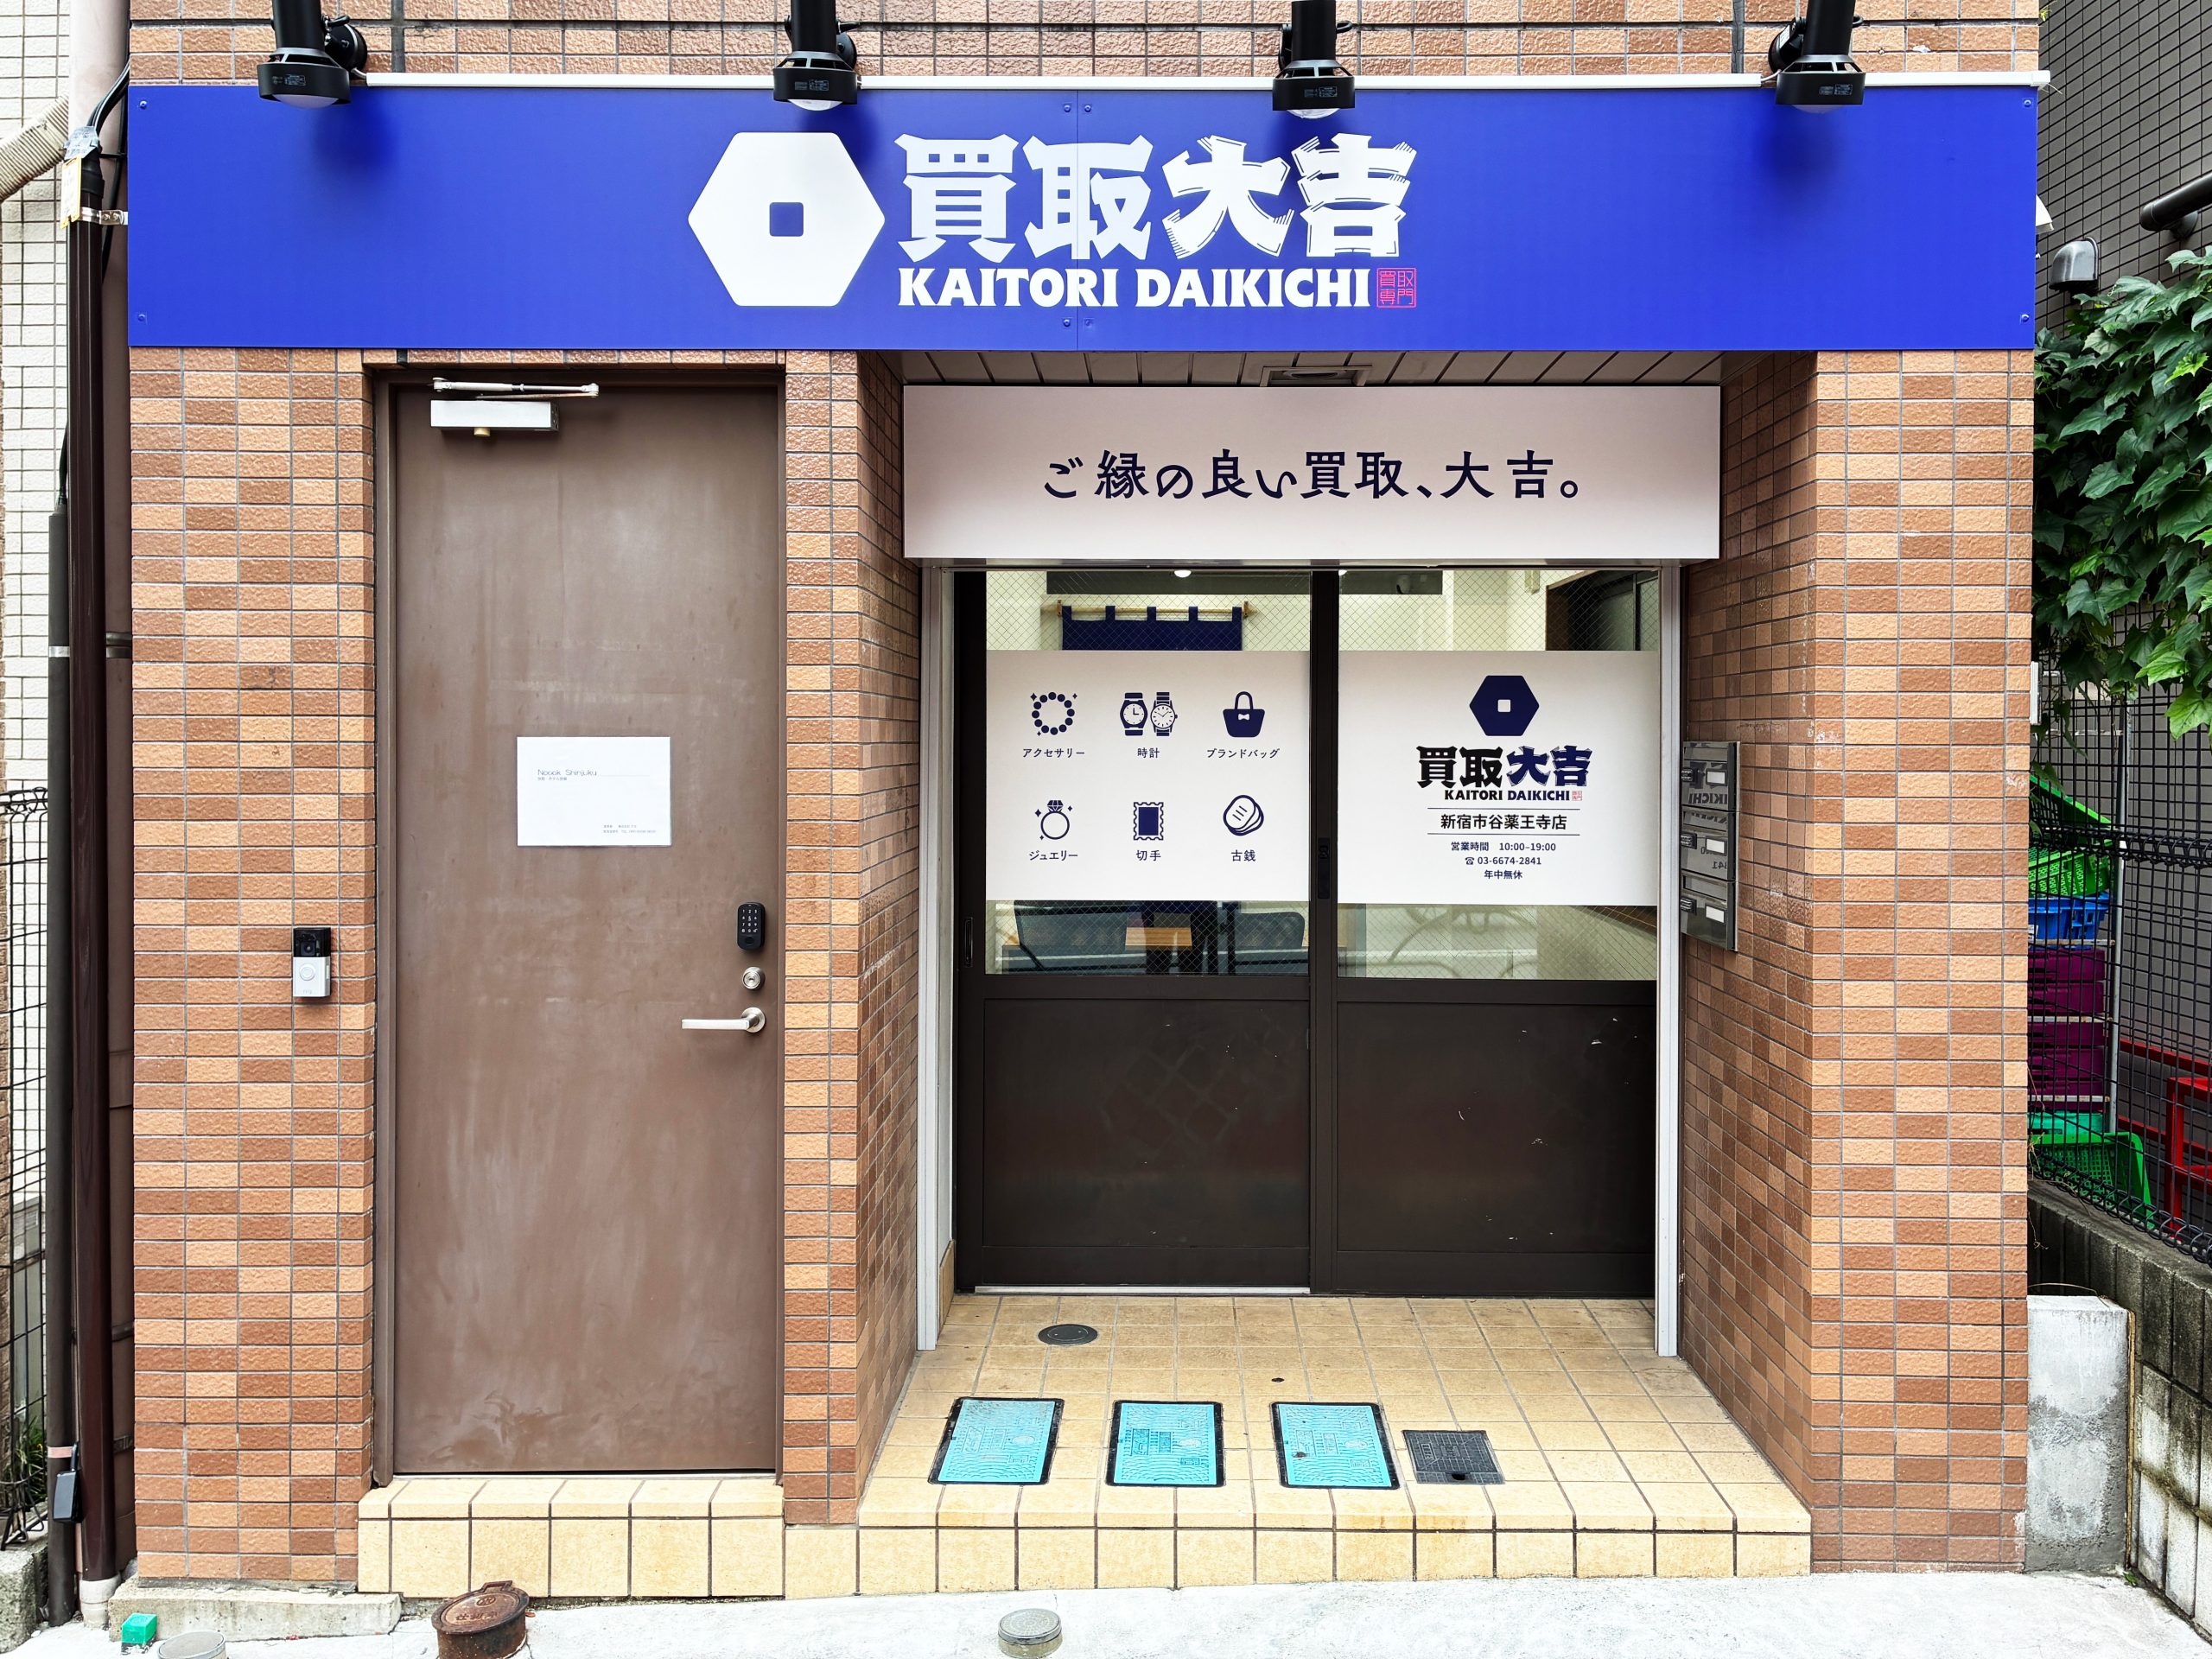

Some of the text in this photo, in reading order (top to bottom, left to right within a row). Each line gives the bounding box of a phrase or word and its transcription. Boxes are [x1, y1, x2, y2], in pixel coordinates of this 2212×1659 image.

[893, 132, 1417, 264] 買取大吉
[898, 268, 1371, 308] KAITORI DAIKICHI
[1044, 448, 1580, 499] ご縁の良い買取、大吉。
[1022, 747, 1085, 759] アクセサリー
[1137, 747, 1160, 759] 時計
[1206, 747, 1281, 760] ブランドバッグ
[1415, 745, 1592, 788] 買取大吉
[1444, 789, 1503, 801] KAITORI
[1507, 790, 1570, 801] DAIKICHI
[1440, 813, 1567, 830] 新宿市谷薬王寺店
[1451, 841, 1490, 852] 営業時間
[1028, 849, 1078, 861] ジュエリー
[1135, 849, 1161, 861] 切手
[1230, 849, 1256, 862] 古銭
[1477, 856, 1542, 866] 03-6674-2841
[1484, 869, 1523, 880] 年中無休
